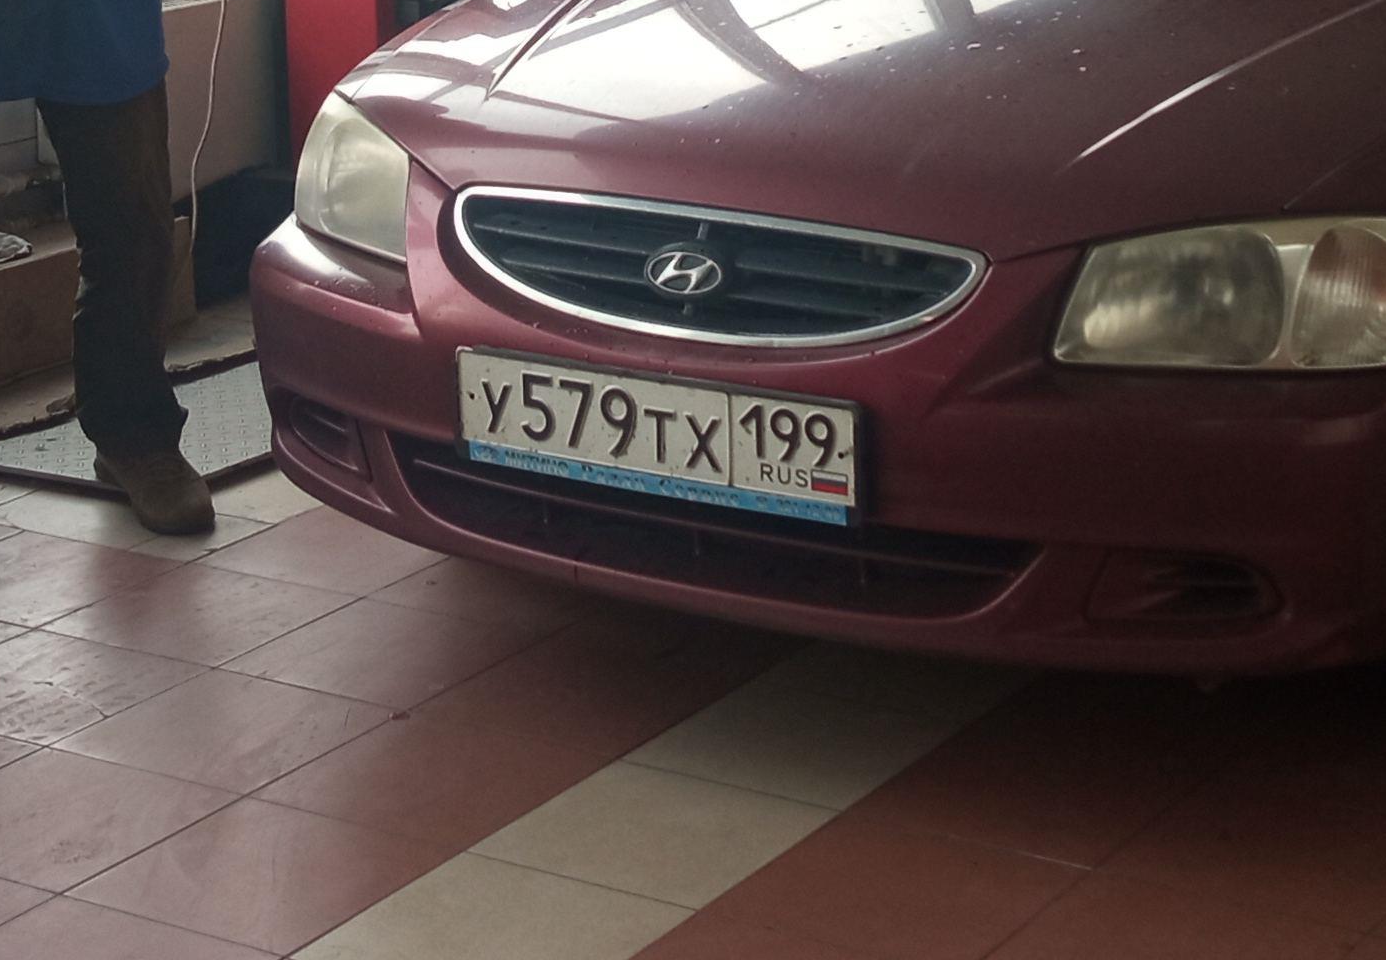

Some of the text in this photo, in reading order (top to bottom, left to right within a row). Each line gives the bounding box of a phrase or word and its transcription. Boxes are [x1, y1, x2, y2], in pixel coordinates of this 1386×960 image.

[480, 371, 838, 473] У579ТХ 199
[759, 462, 809, 489] RUS
